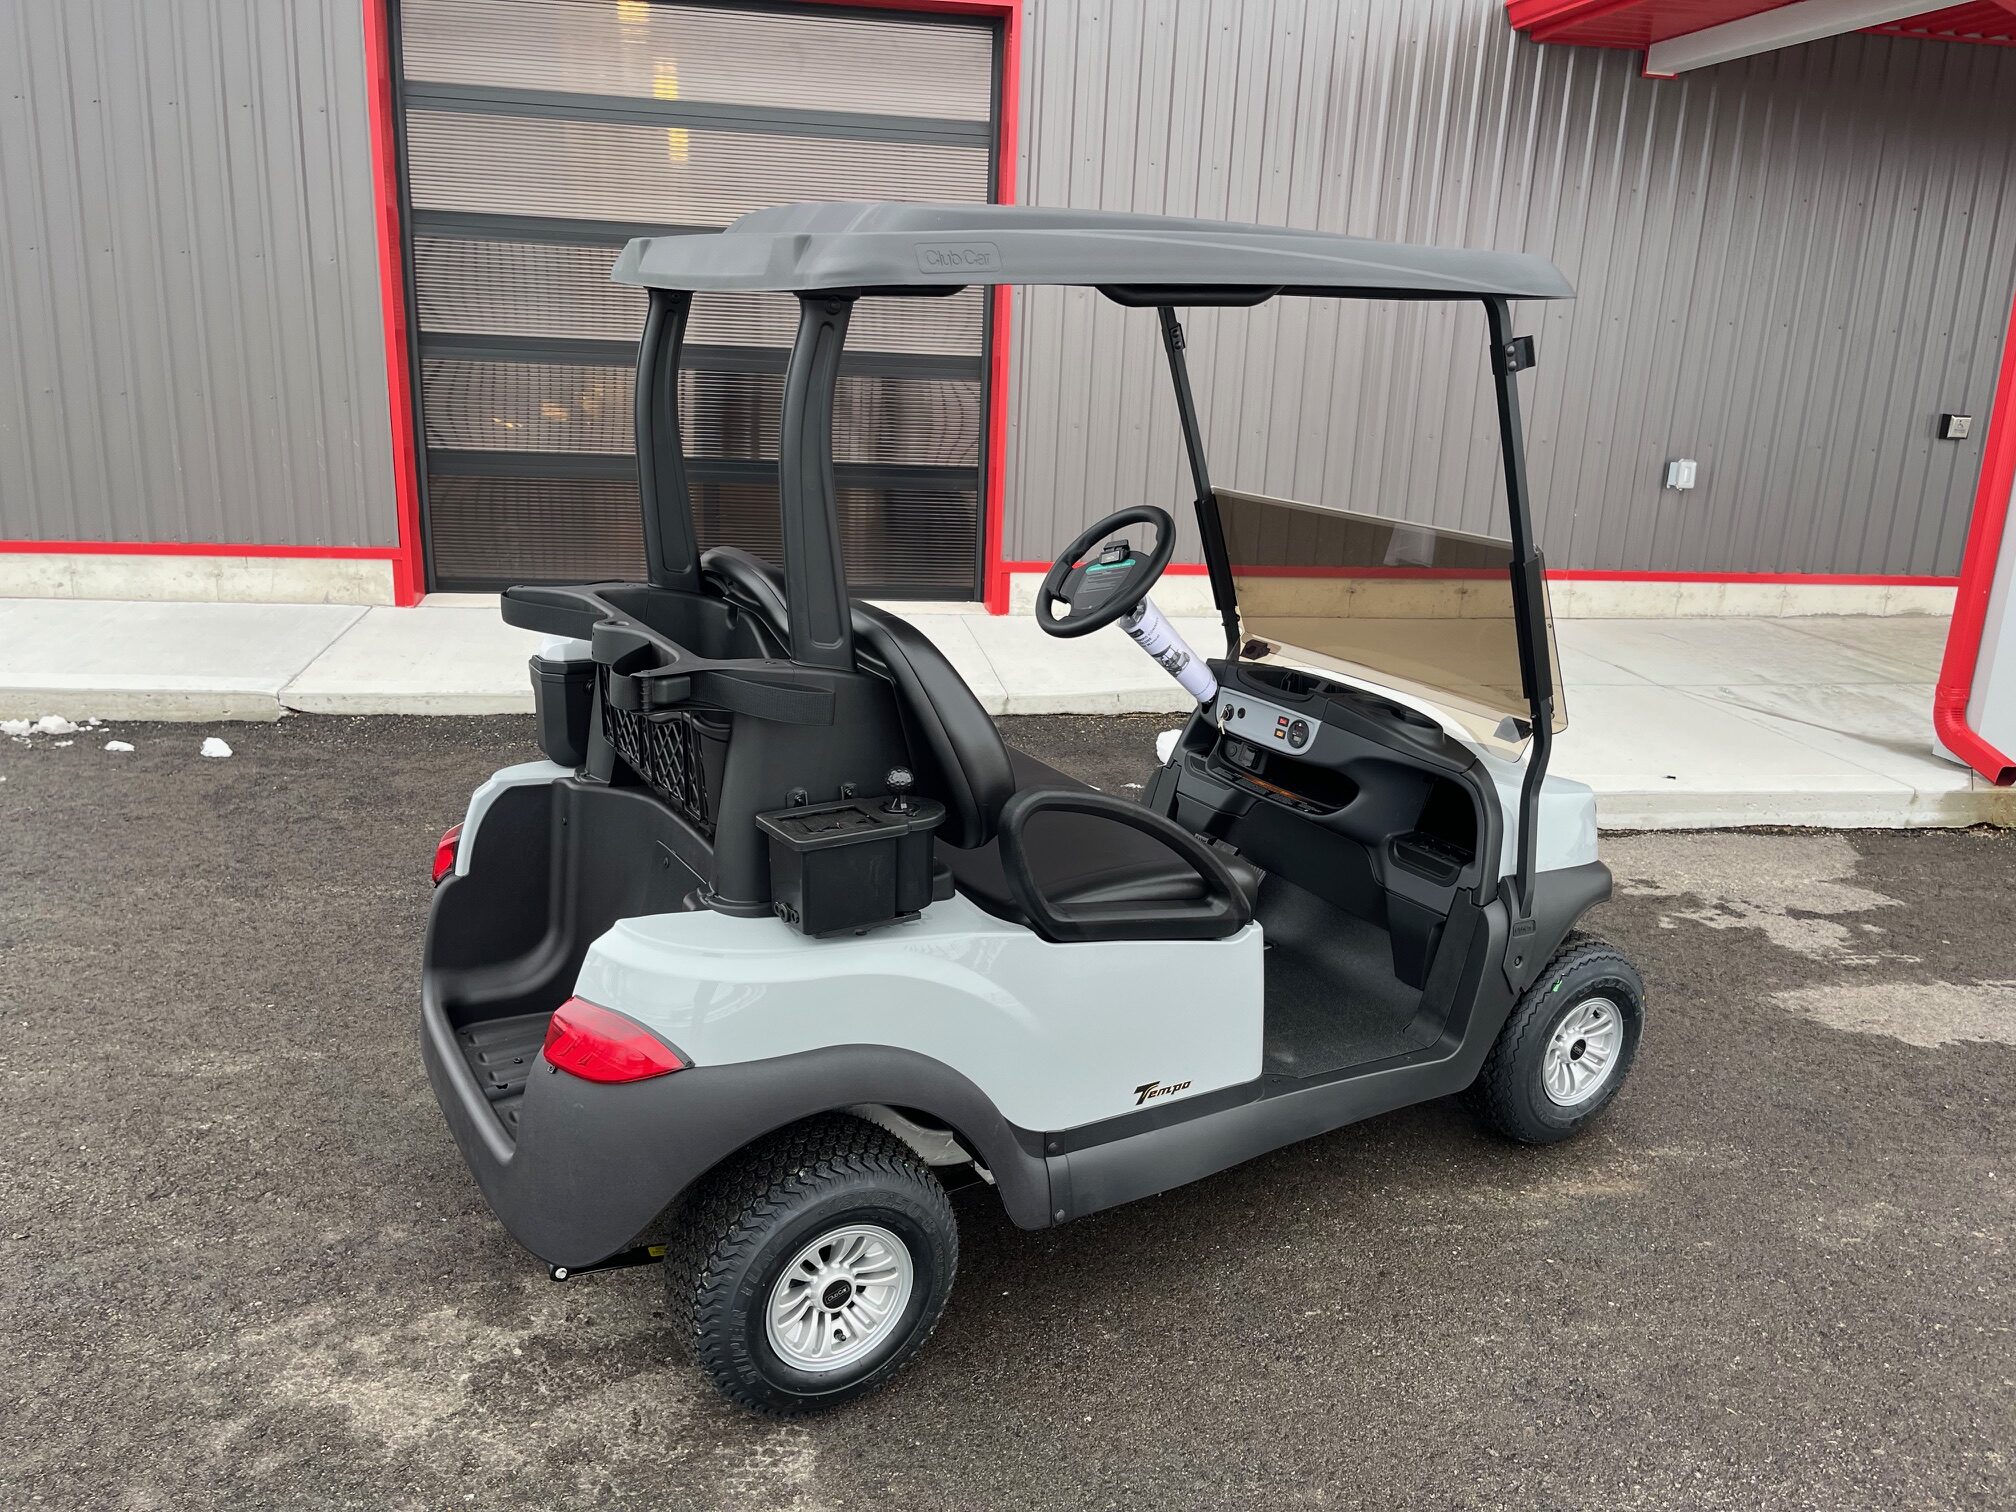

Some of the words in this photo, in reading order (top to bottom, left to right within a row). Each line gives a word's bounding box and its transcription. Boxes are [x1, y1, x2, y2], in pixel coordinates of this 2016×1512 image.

[926, 249, 962, 267] Club
[962, 249, 991, 266] Car
[1133, 1080, 1192, 1106] Tempo
